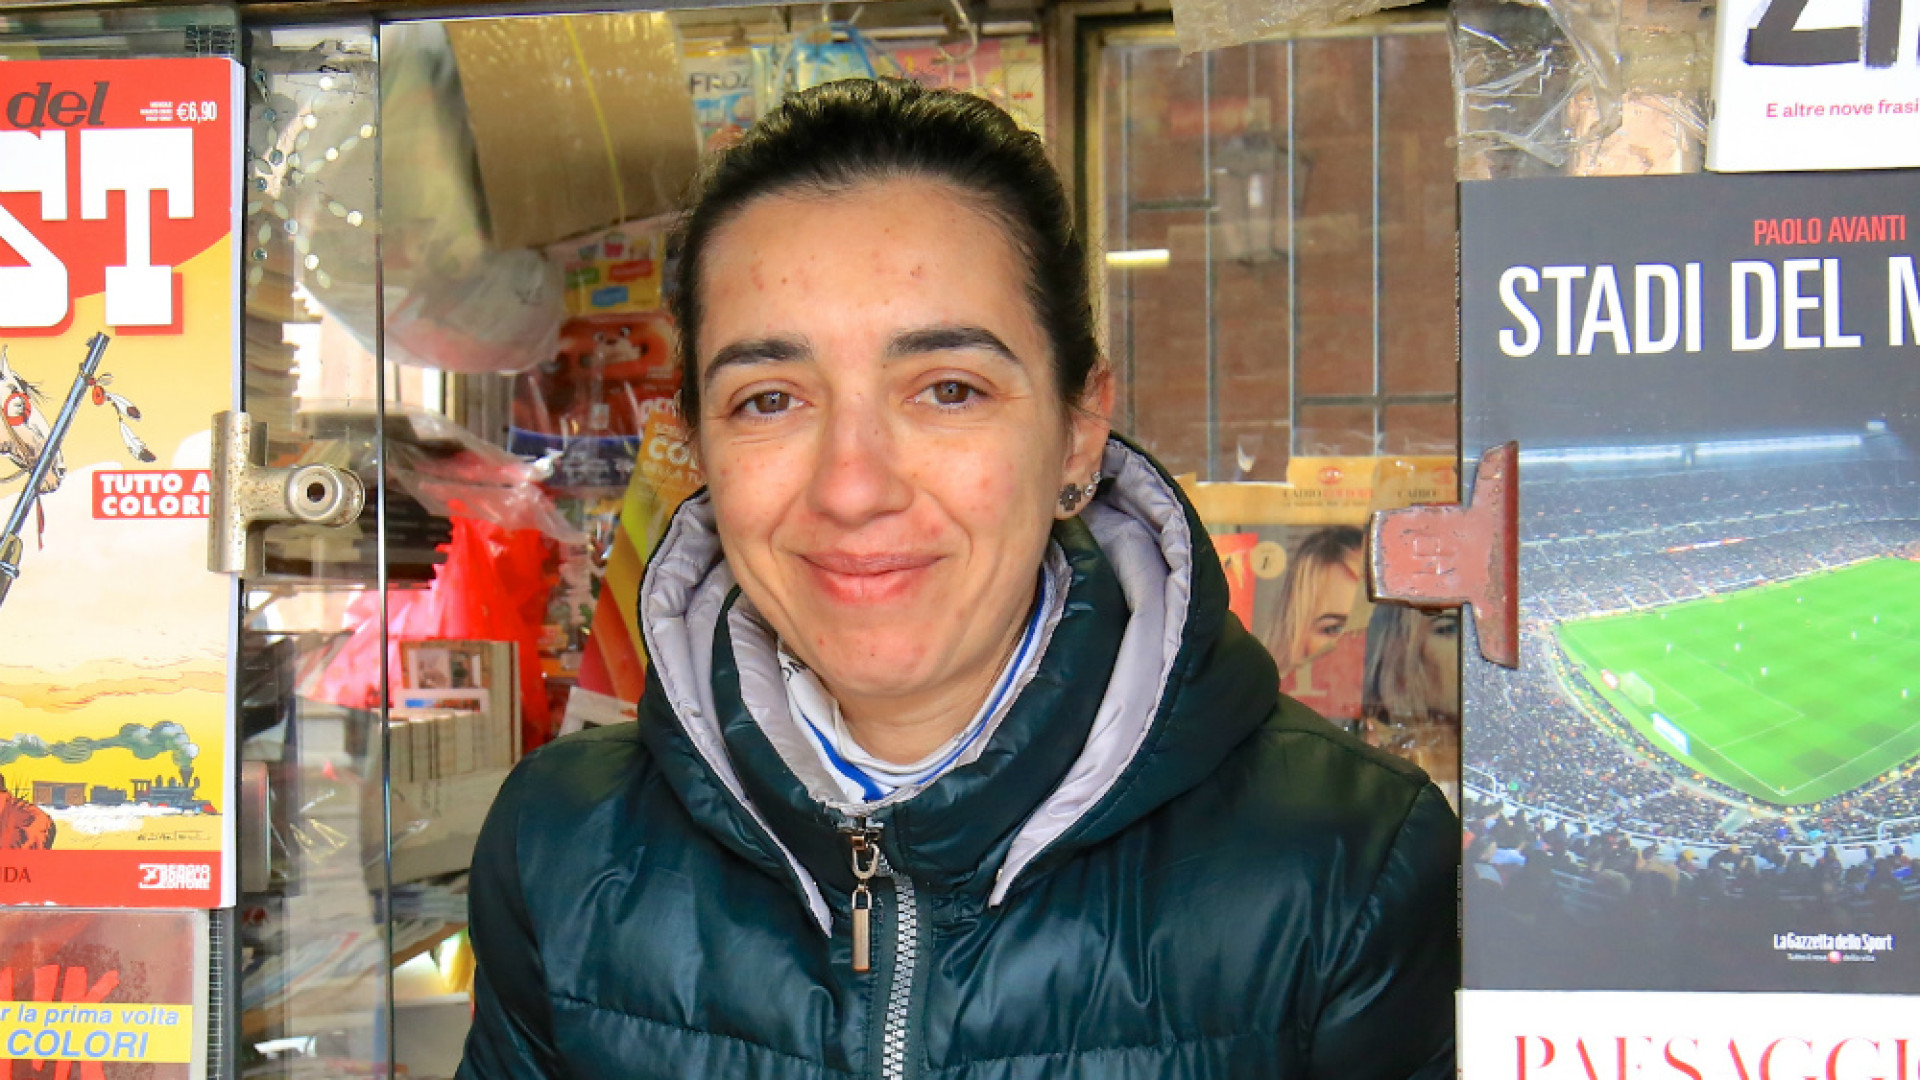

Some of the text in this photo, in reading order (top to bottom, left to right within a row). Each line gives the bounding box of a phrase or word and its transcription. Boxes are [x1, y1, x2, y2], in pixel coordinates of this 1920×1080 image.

[6, 81, 110, 128] del
[176, 101, 217, 124] €6,90
[1766, 99, 1920, 118] E altre nove frasi
[1753, 215, 1906, 246] PAOLO AVANTI
[1499, 262, 1702, 357] STADI
[1731, 257, 1862, 352] DEL
[100, 473, 211, 494] TUTTO A
[102, 496, 210, 516] COLORI
[1773, 933, 1786, 950] La
[1787, 931, 1834, 950] Gazzetta
[1861, 932, 1893, 953] Sport
[18, 1003, 37, 1022] la
[44, 1005, 112, 1026] prima
[121, 1007, 179, 1025] volta
[7, 1028, 149, 1058] COLORI
